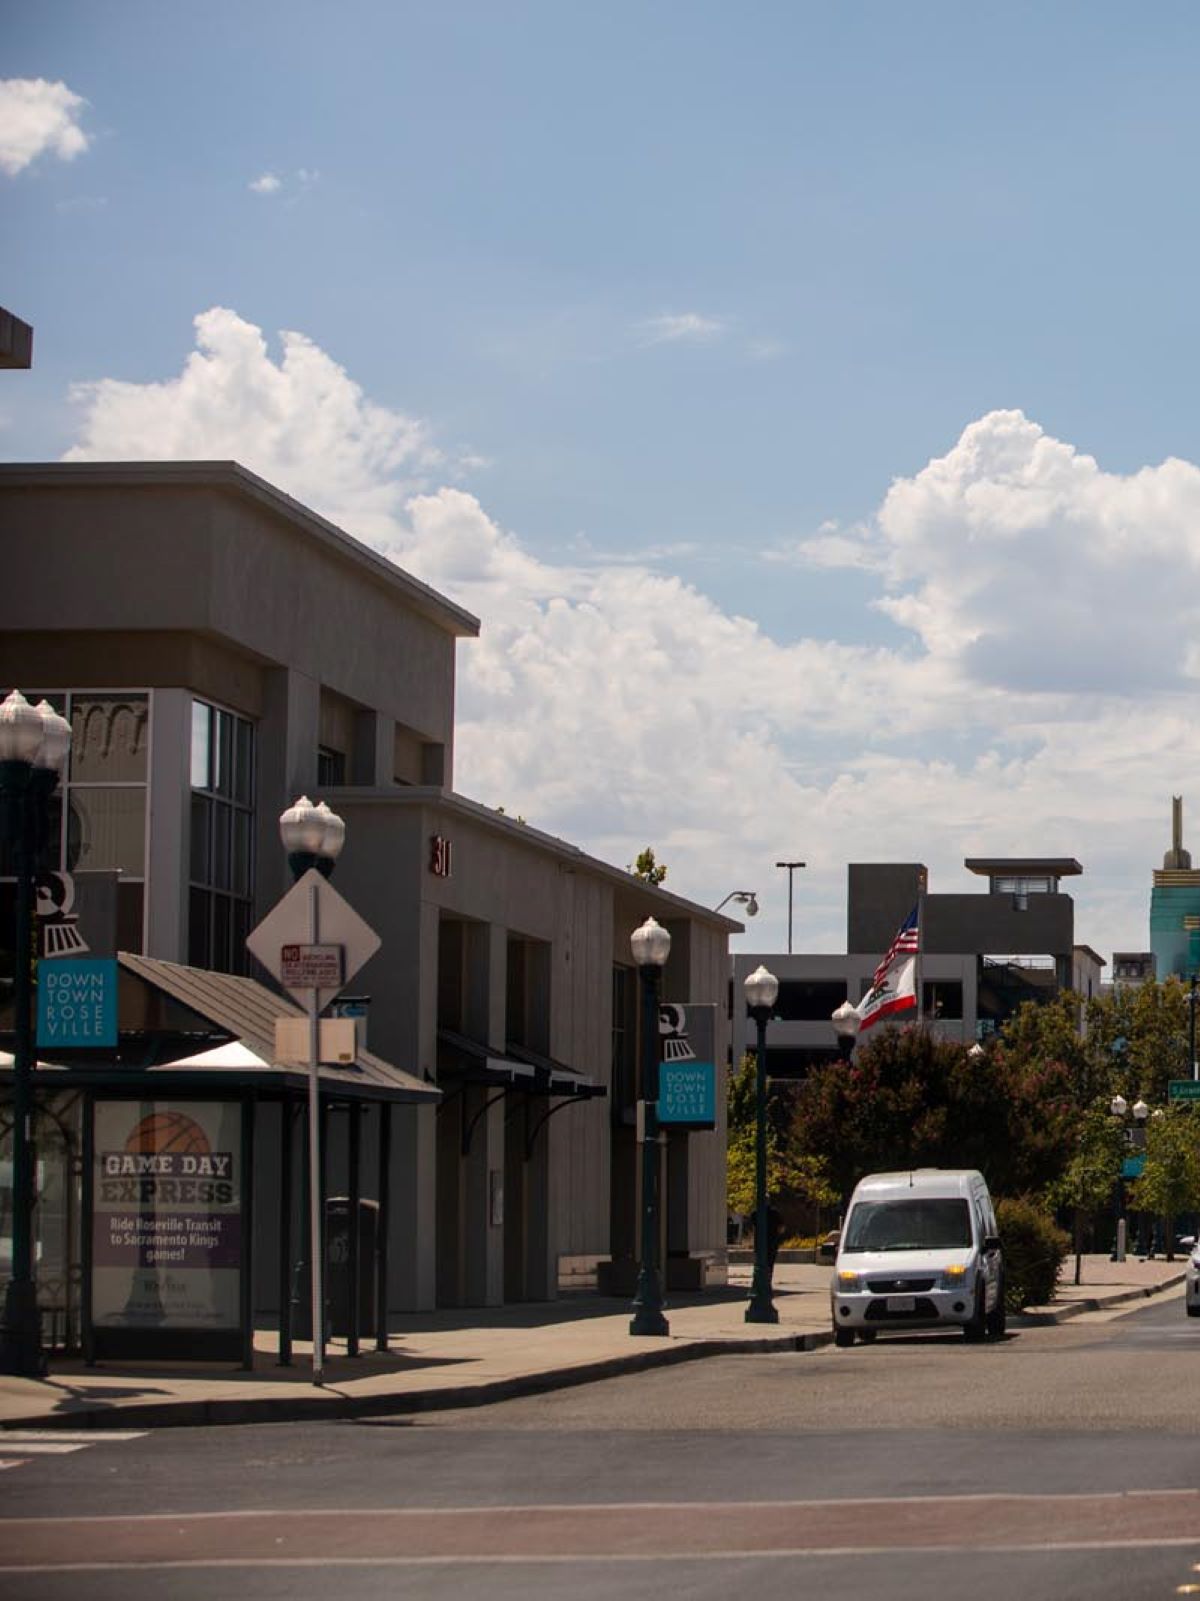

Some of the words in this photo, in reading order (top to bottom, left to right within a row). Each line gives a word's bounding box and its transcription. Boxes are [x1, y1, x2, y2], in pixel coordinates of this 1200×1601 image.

[433, 836, 453, 877] 311
[284, 947, 299, 960] NO
[47, 973, 104, 988] DOWN
[47, 989, 104, 1004] TOWN
[47, 1005, 103, 1020] ROSE
[47, 1021, 103, 1036] VILLE
[666, 1071, 706, 1082] DOWN
[666, 1083, 706, 1093] TOWN
[666, 1093, 705, 1104] ROSE
[666, 1104, 706, 1115] VILLE
[105, 1155, 173, 1175] GAME
[182, 1156, 230, 1176] DAY
[101, 1179, 233, 1204] EXPRESS
[110, 1216, 135, 1231] Ride
[135, 1216, 184, 1231] Roseville
[184, 1218, 222, 1232] Transit
[110, 1234, 122, 1245] to
[123, 1232, 188, 1246] Sacramento
[189, 1234, 219, 1248] Kings
[145, 1248, 186, 1263] games!
